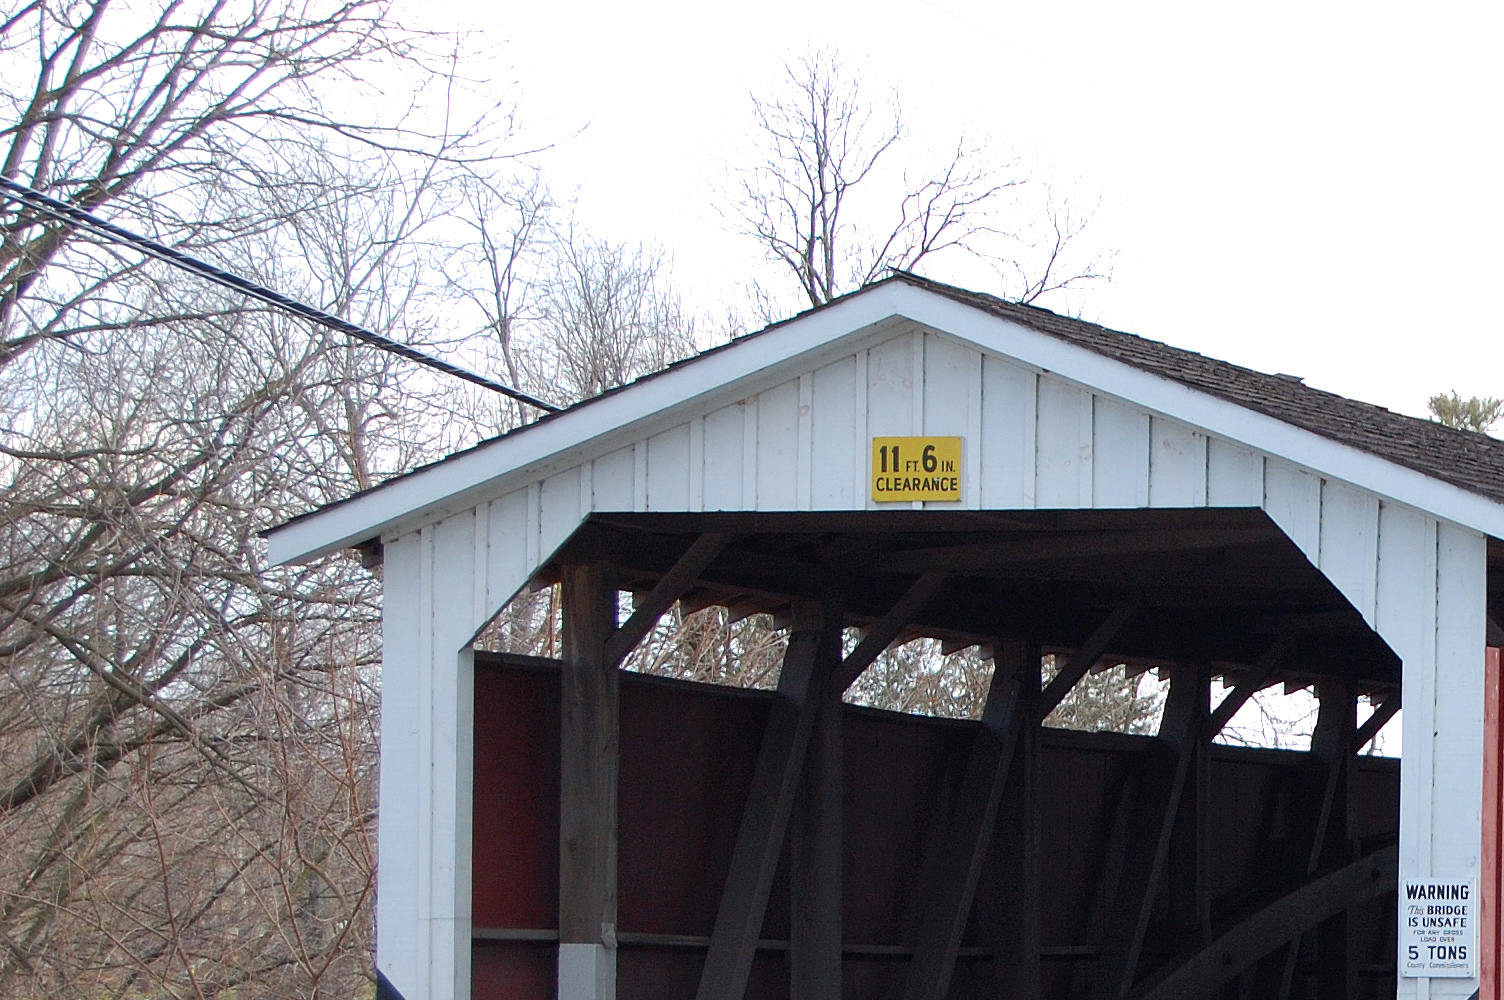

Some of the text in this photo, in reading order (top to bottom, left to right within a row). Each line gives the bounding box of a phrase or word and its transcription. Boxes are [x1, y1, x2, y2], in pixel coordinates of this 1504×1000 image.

[879, 445, 900, 473] 11
[922, 444, 938, 473] 6
[876, 477, 958, 492] CLEARANCE
[1406, 884, 1469, 900] WARNING
[1427, 905, 1468, 916] BRIDGE
[1408, 917, 1467, 928] IS UNSAFE
[1408, 945, 1467, 960] 5 TONS
